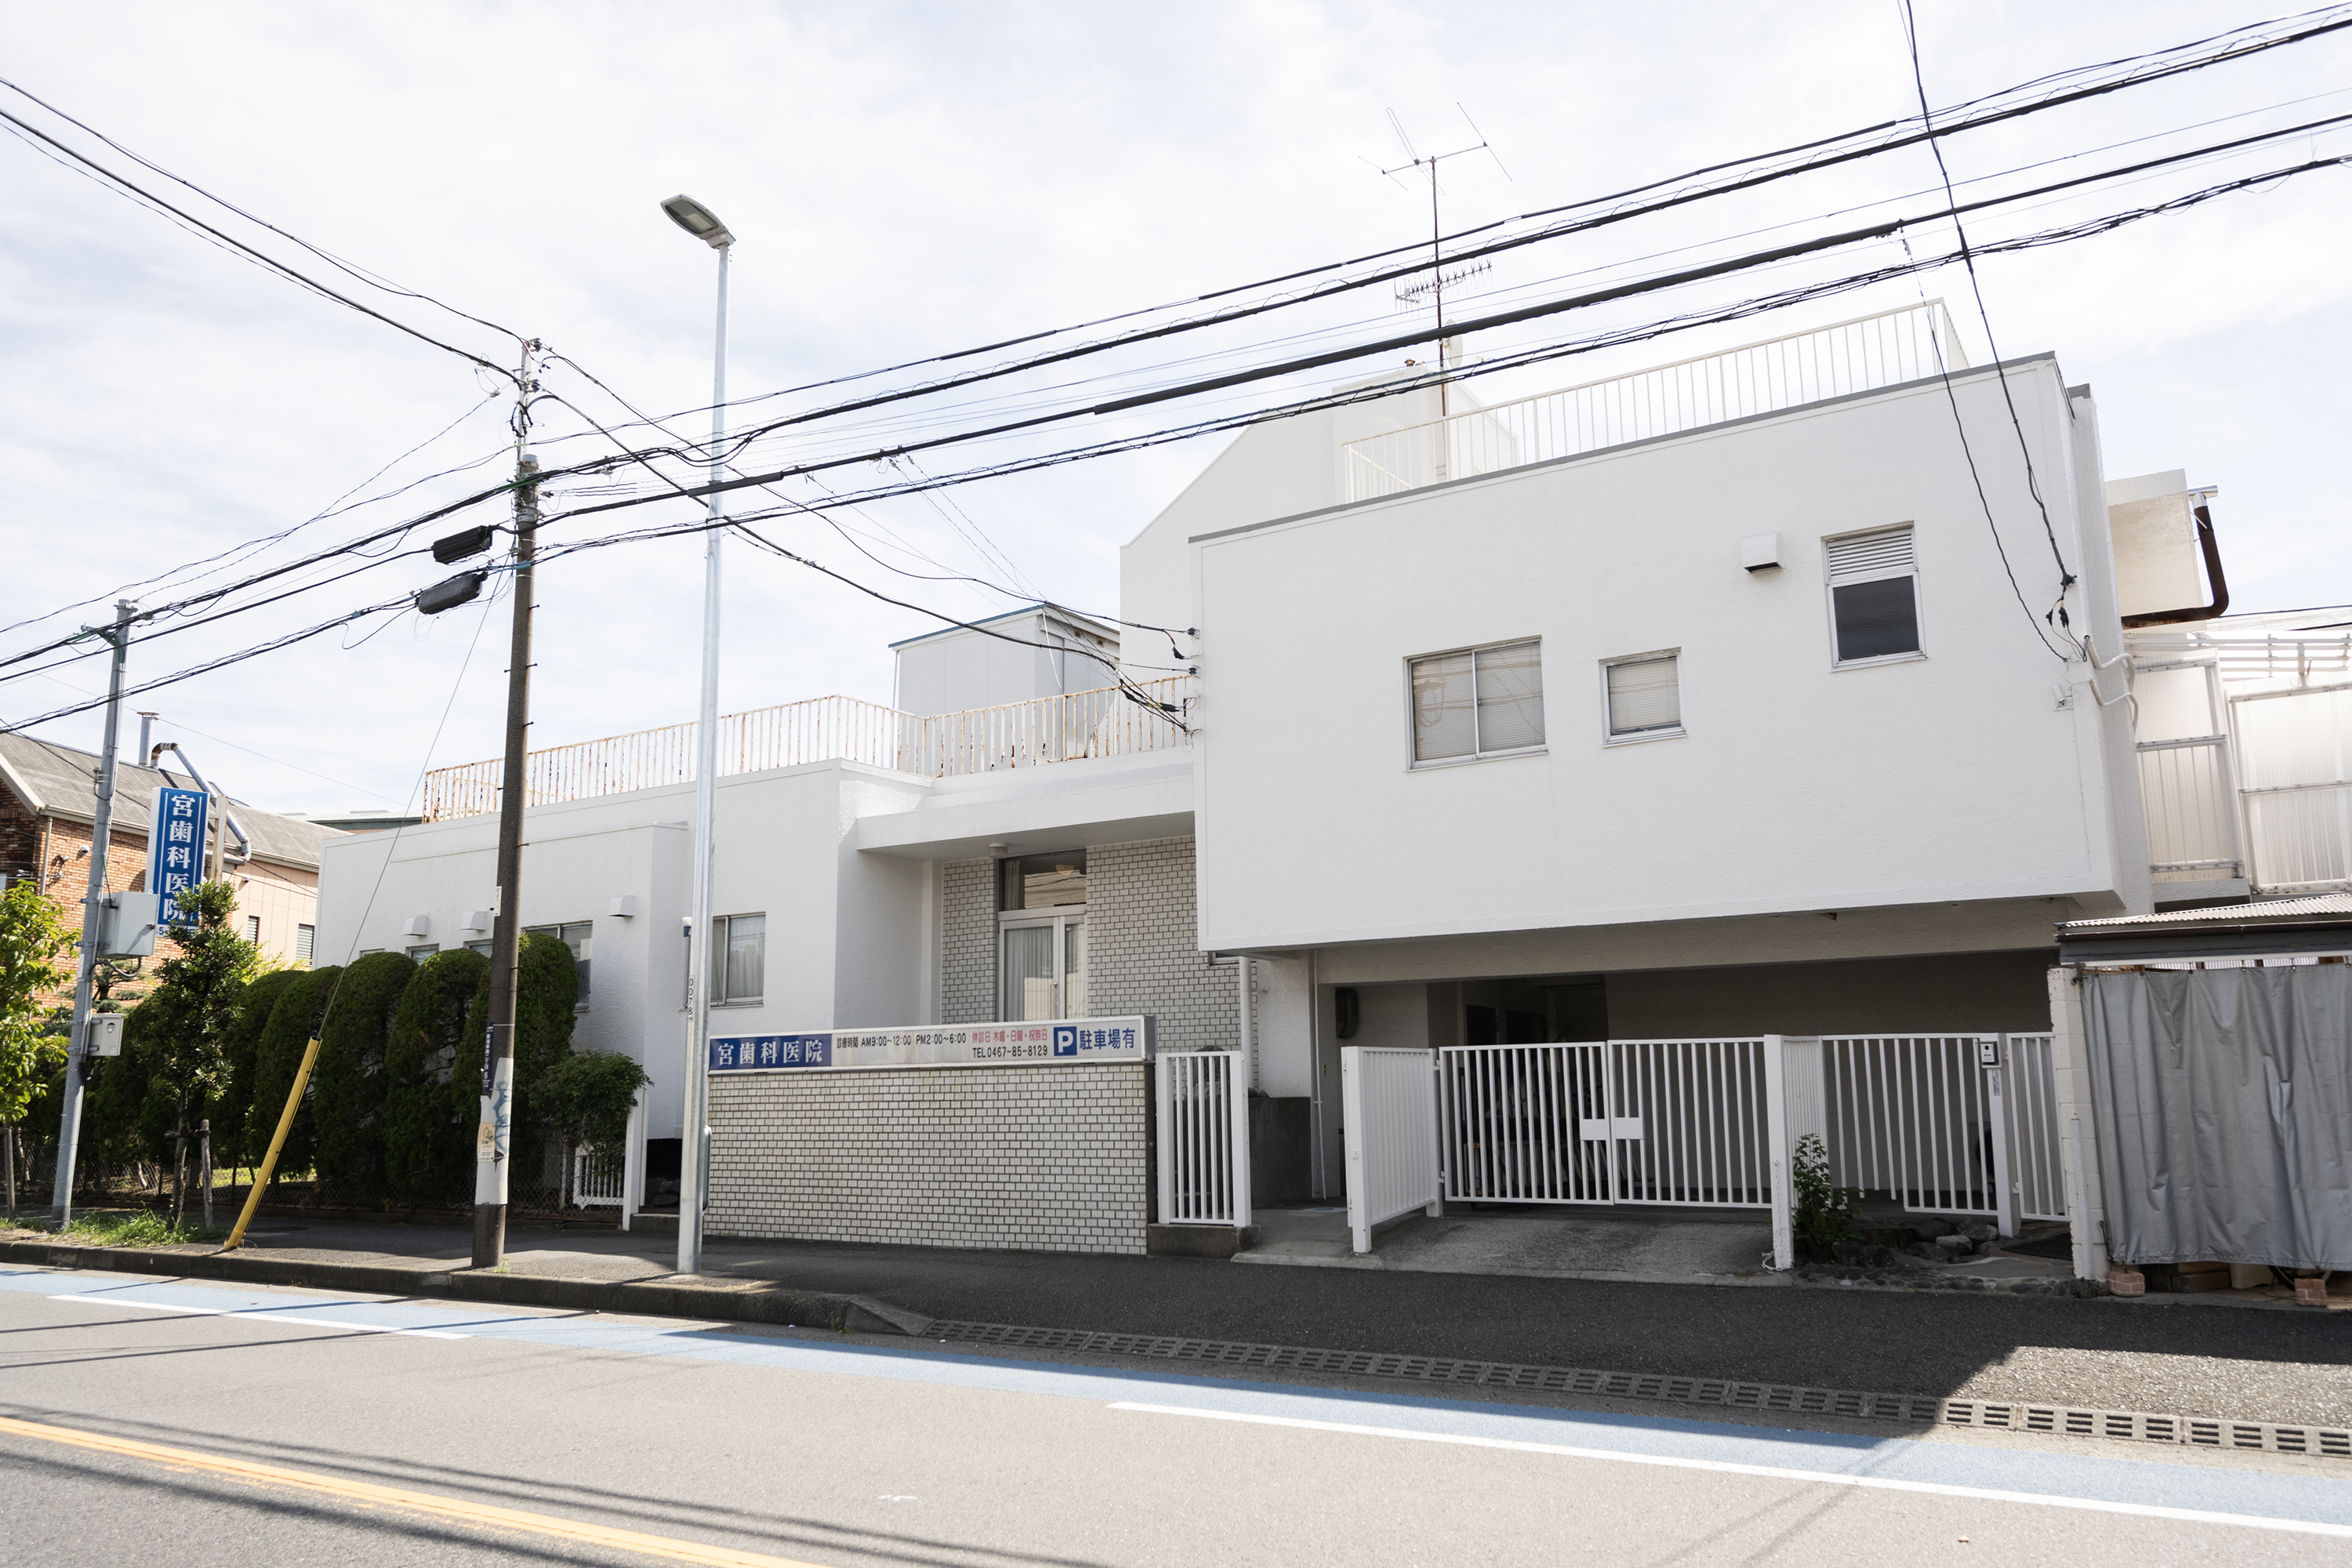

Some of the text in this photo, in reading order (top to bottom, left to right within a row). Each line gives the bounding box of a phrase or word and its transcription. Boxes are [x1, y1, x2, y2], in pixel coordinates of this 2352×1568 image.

[837, 1036, 858, 1049] 診療時間
[972, 1031, 990, 1044] 休診日
[1058, 1030, 1074, 1054] P
[1079, 1028, 1136, 1051] 駐車場有
[718, 1039, 822, 1065] 宮歯科医院
